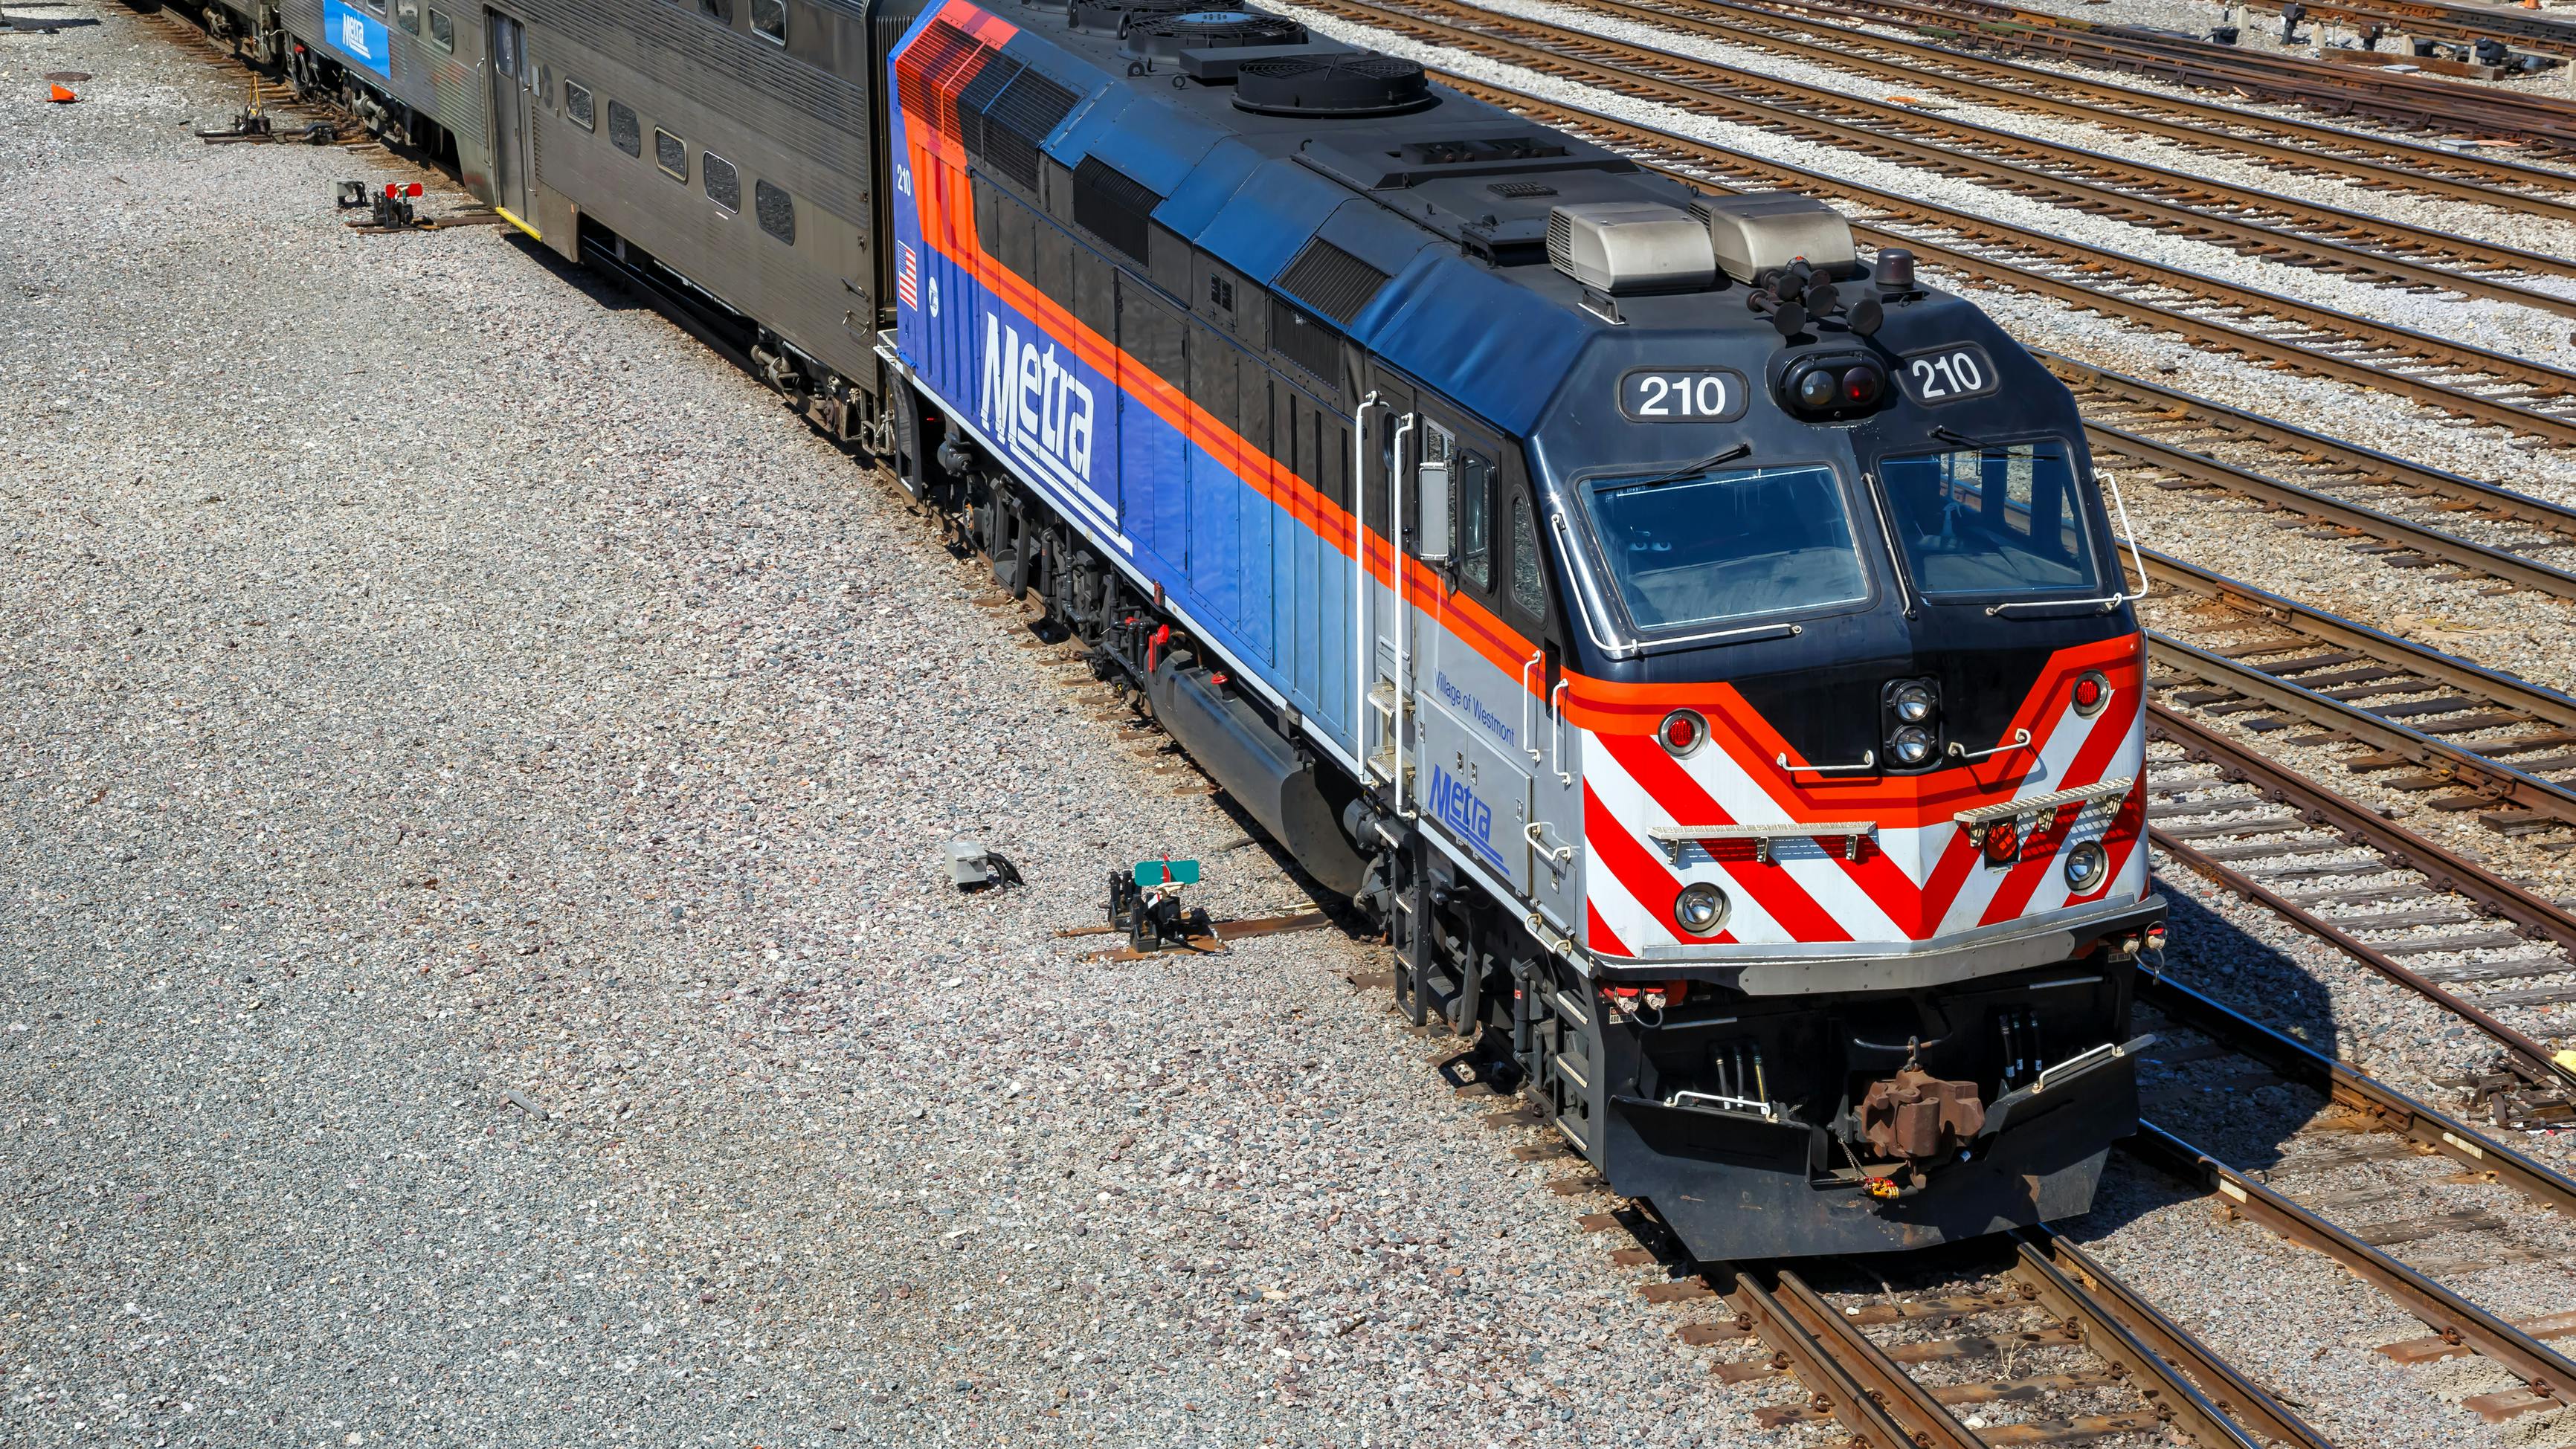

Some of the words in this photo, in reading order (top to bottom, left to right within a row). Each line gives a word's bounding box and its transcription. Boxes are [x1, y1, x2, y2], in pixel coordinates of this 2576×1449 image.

[343, 13, 364, 46] Metra
[897, 164, 911, 197] 210
[1640, 376, 1726, 416] 210
[1912, 352, 1982, 398] 210
[981, 311, 1094, 483] Metra
[1434, 668, 1461, 706] Village
[1463, 694, 1471, 713] of
[1473, 697, 1515, 747] Westmont
[1429, 764, 1491, 844] Metra
[1588, 955, 1594, 972] F
